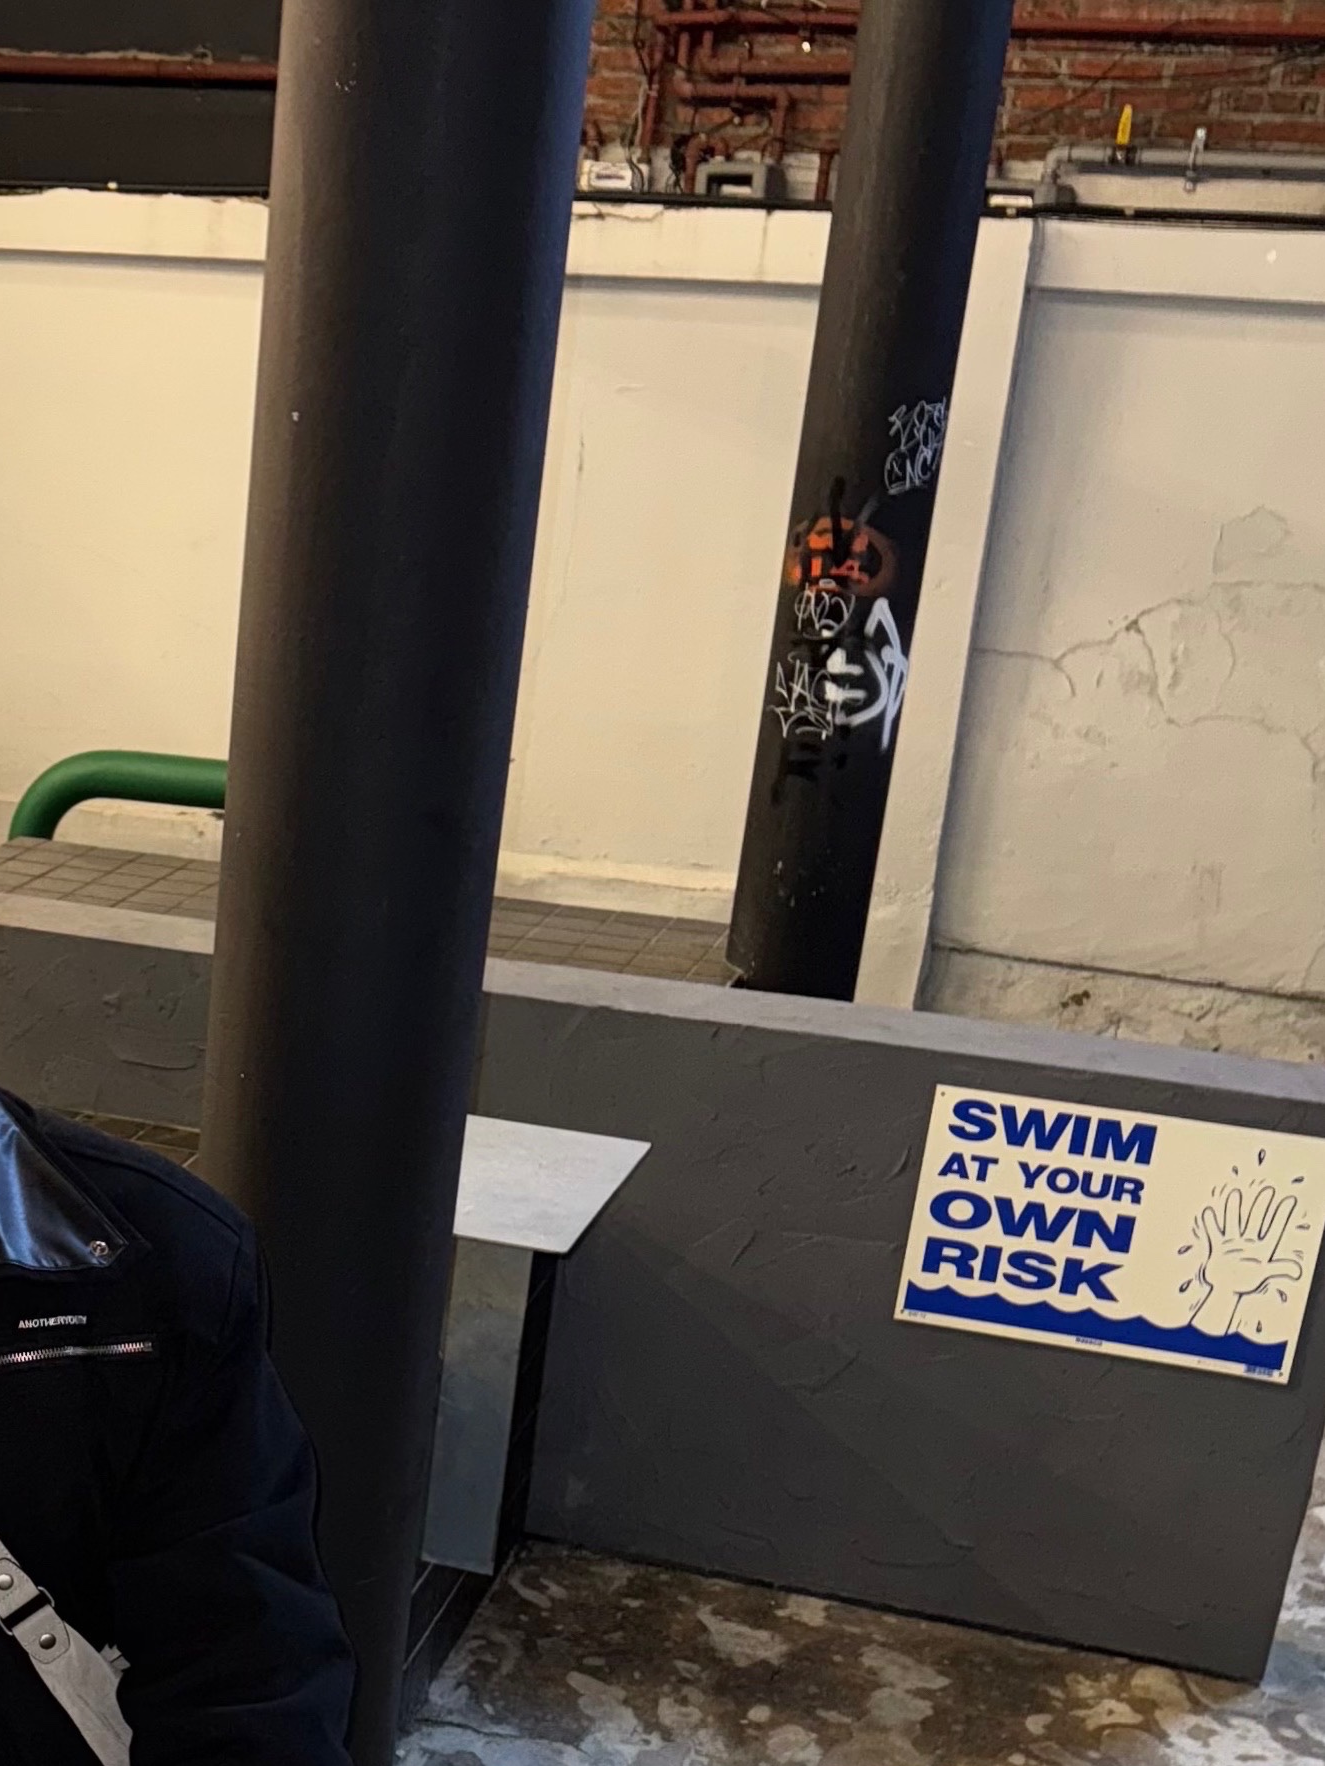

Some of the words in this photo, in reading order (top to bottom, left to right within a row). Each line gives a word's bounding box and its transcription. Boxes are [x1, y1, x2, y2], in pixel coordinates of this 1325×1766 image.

[948, 1099, 1158, 1166] SWIM
[938, 1152, 999, 1182] AT
[1018, 1161, 1145, 1205] YOUR
[929, 1190, 1137, 1254] OWN
[921, 1237, 1124, 1303] RISK
